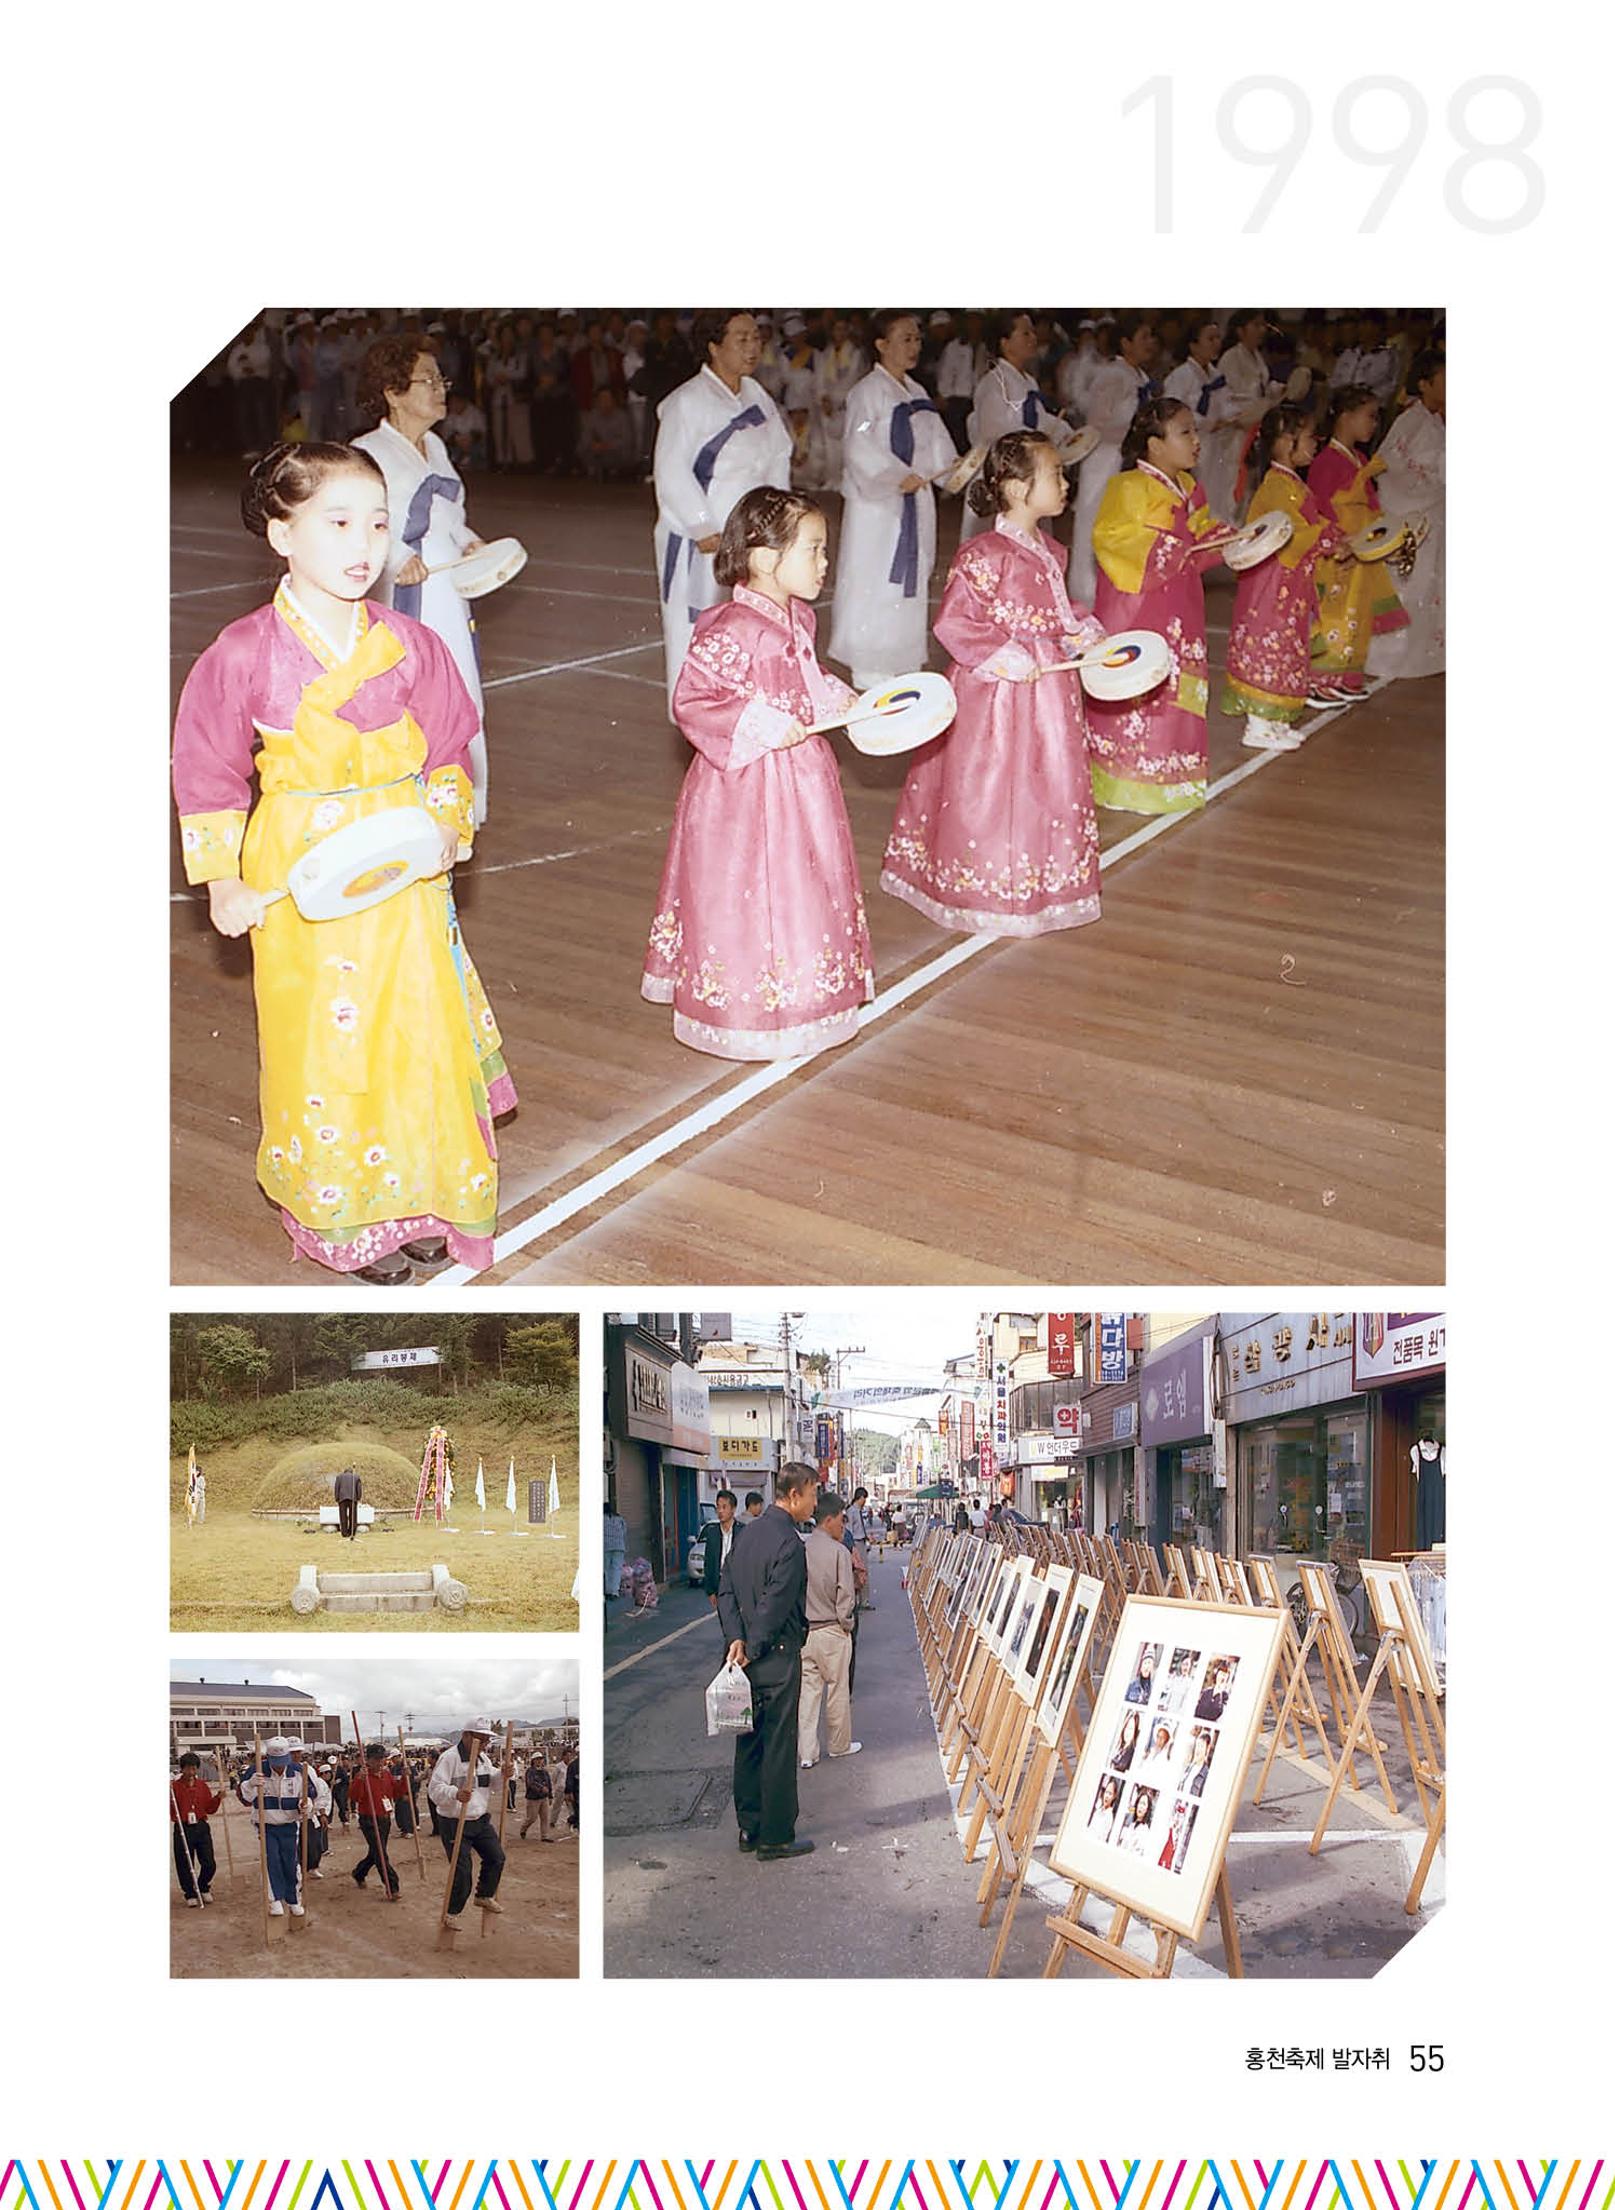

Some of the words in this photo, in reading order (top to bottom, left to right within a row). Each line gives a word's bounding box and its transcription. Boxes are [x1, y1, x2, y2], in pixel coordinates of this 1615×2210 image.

[1393, 1334, 1423, 1365] 전품목
[1056, 1407, 1079, 1434] 약
[722, 1439, 758, 1452] 보디가드
